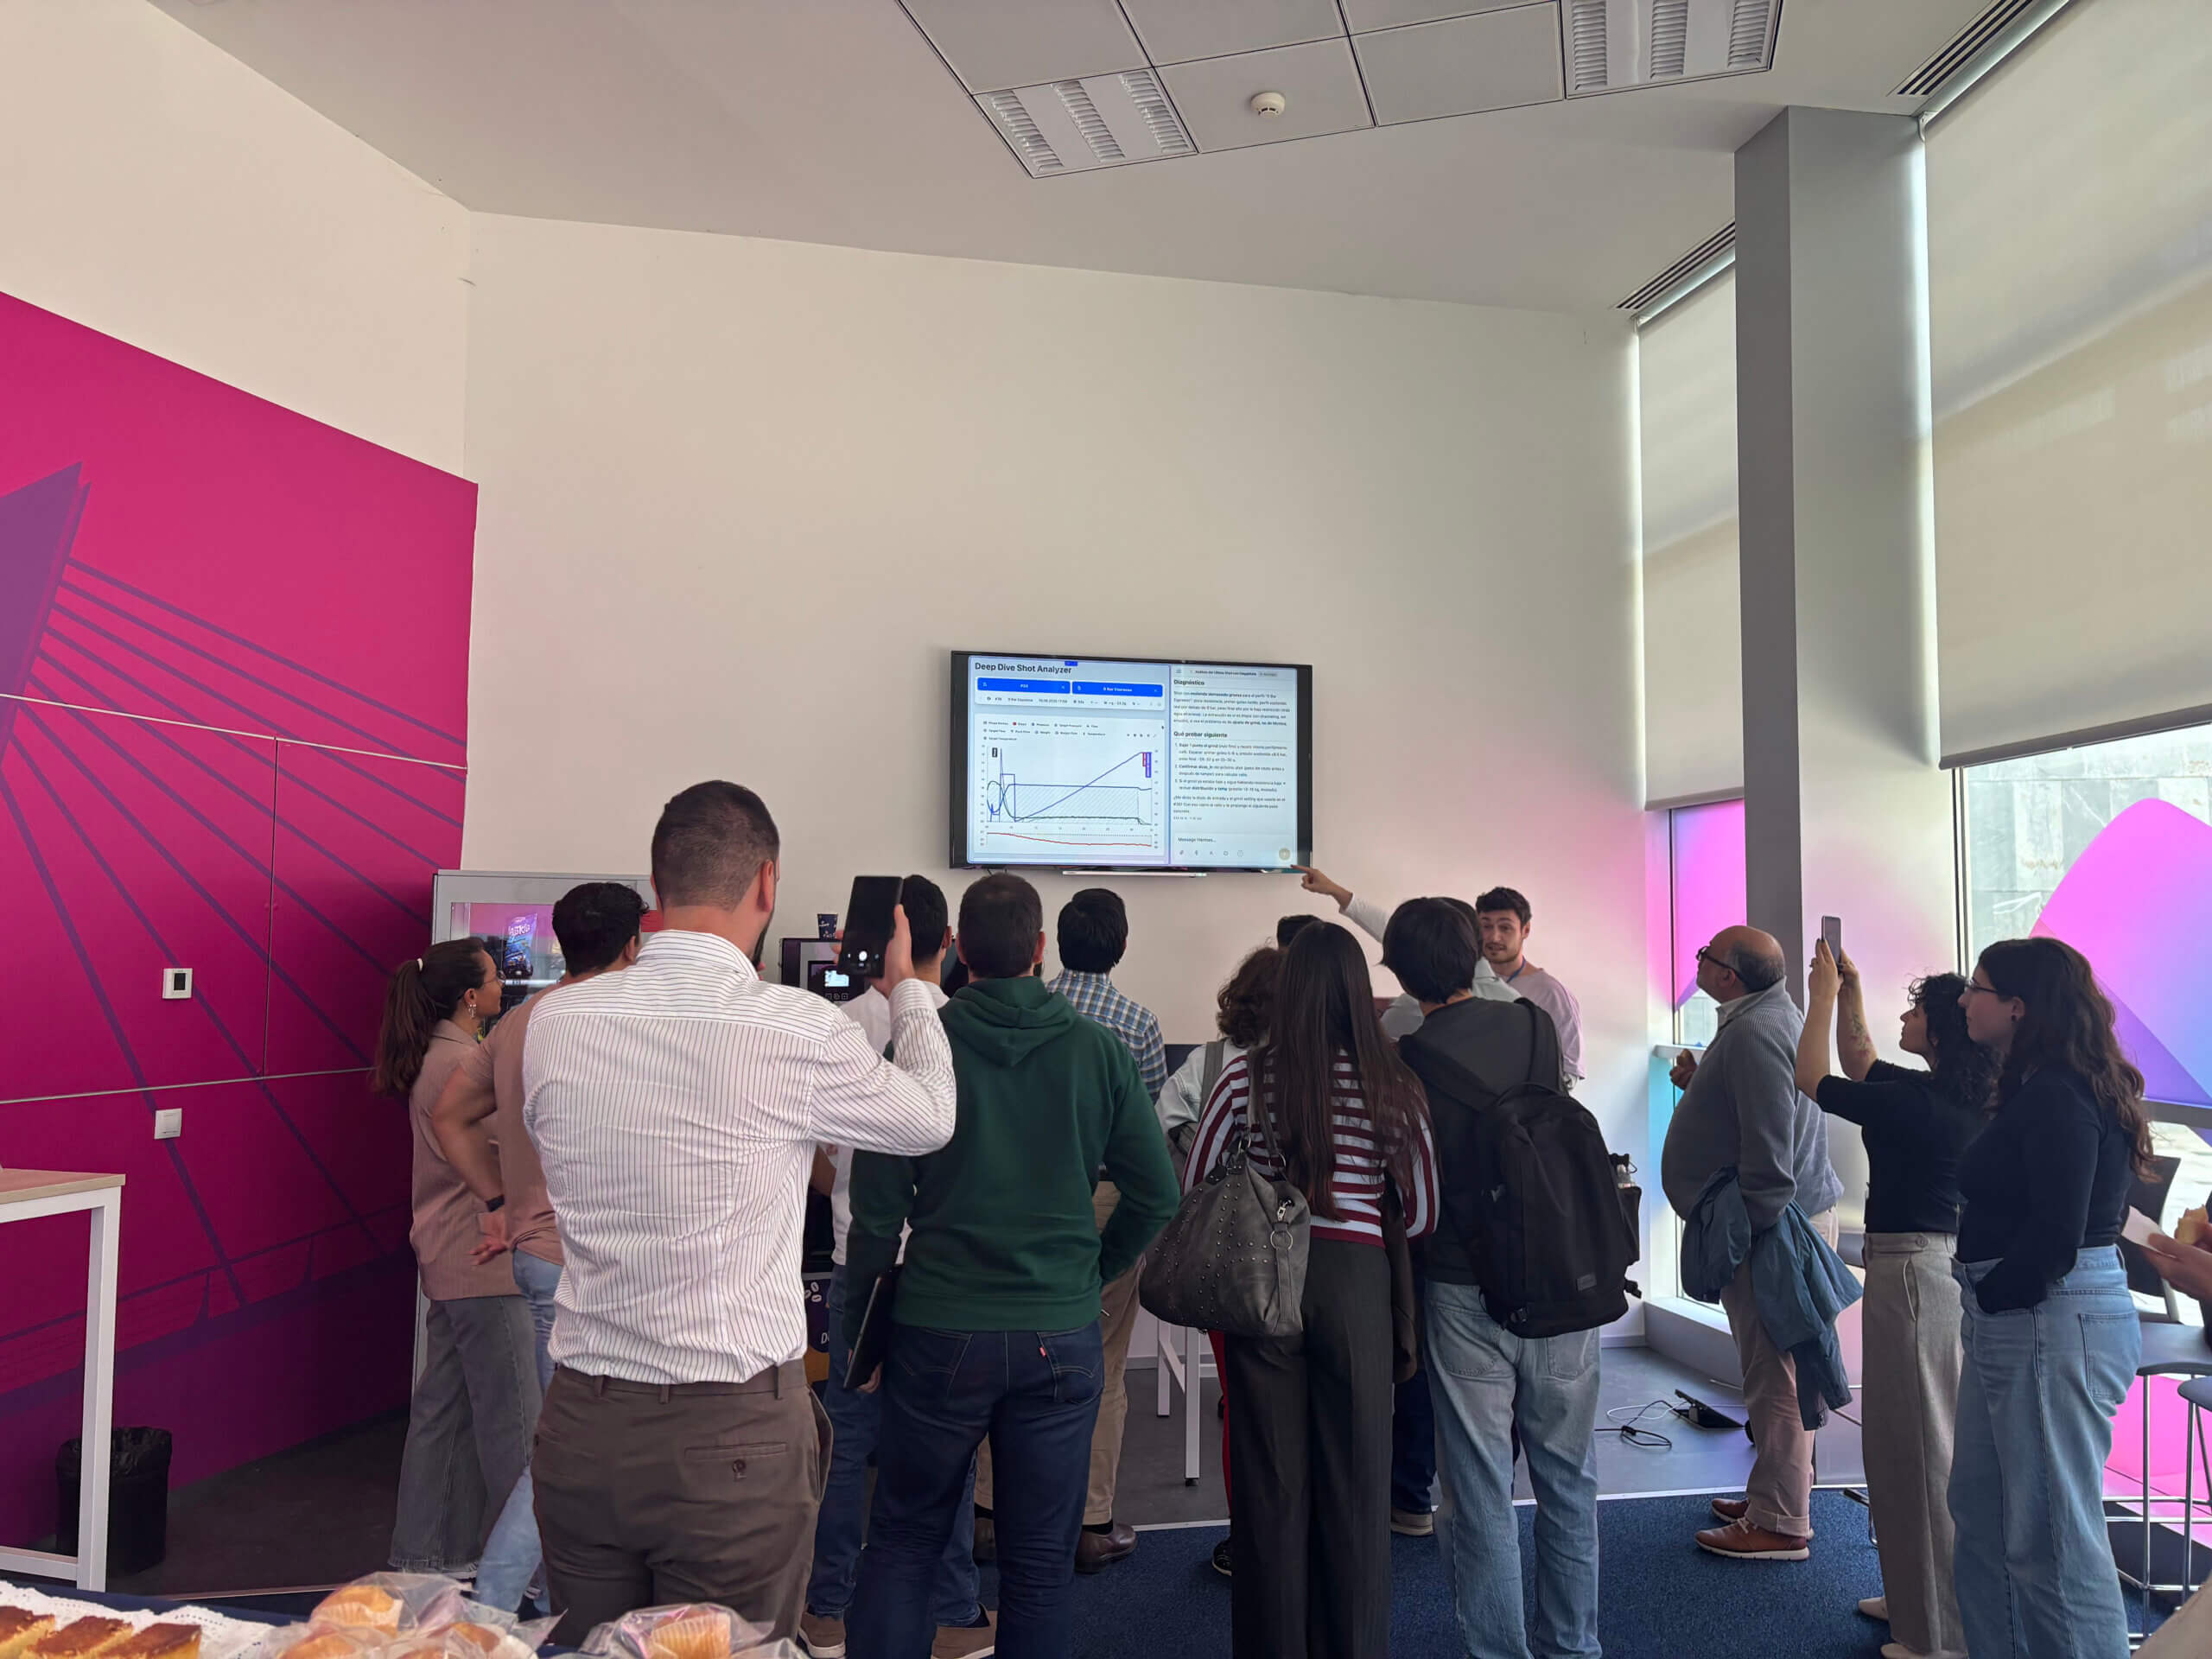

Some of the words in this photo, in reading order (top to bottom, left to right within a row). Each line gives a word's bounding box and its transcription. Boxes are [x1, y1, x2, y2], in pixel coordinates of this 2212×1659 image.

[975, 662, 996, 671] Deep
[1016, 664, 1036, 672] Shot
[1037, 664, 1071, 674] Analyzer
